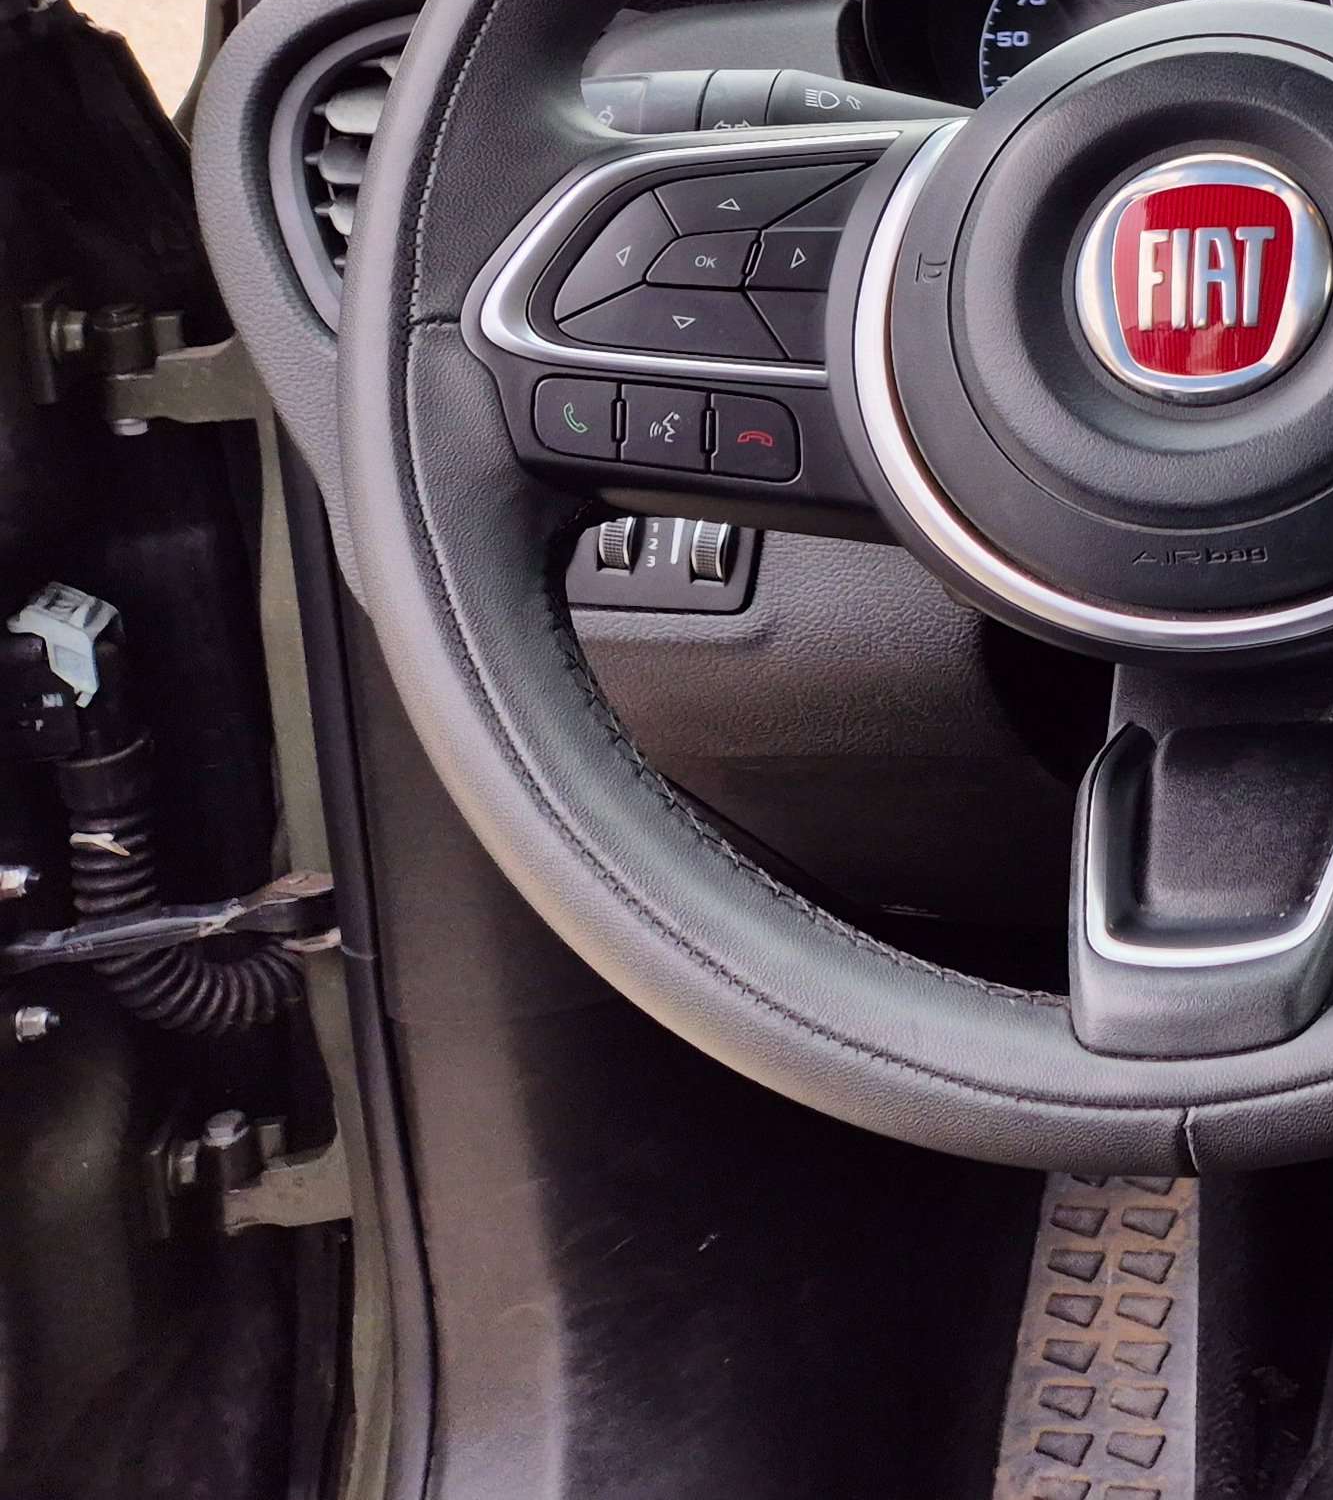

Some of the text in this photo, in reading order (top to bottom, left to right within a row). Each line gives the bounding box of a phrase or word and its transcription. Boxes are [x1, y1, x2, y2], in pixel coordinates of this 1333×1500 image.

[996, 30, 1030, 47] 50
[694, 255, 717, 269] OK
[1136, 225, 1277, 332] FIAT
[652, 522, 659, 533] 1
[648, 537, 659, 550] 2
[646, 555, 656, 568] 3
